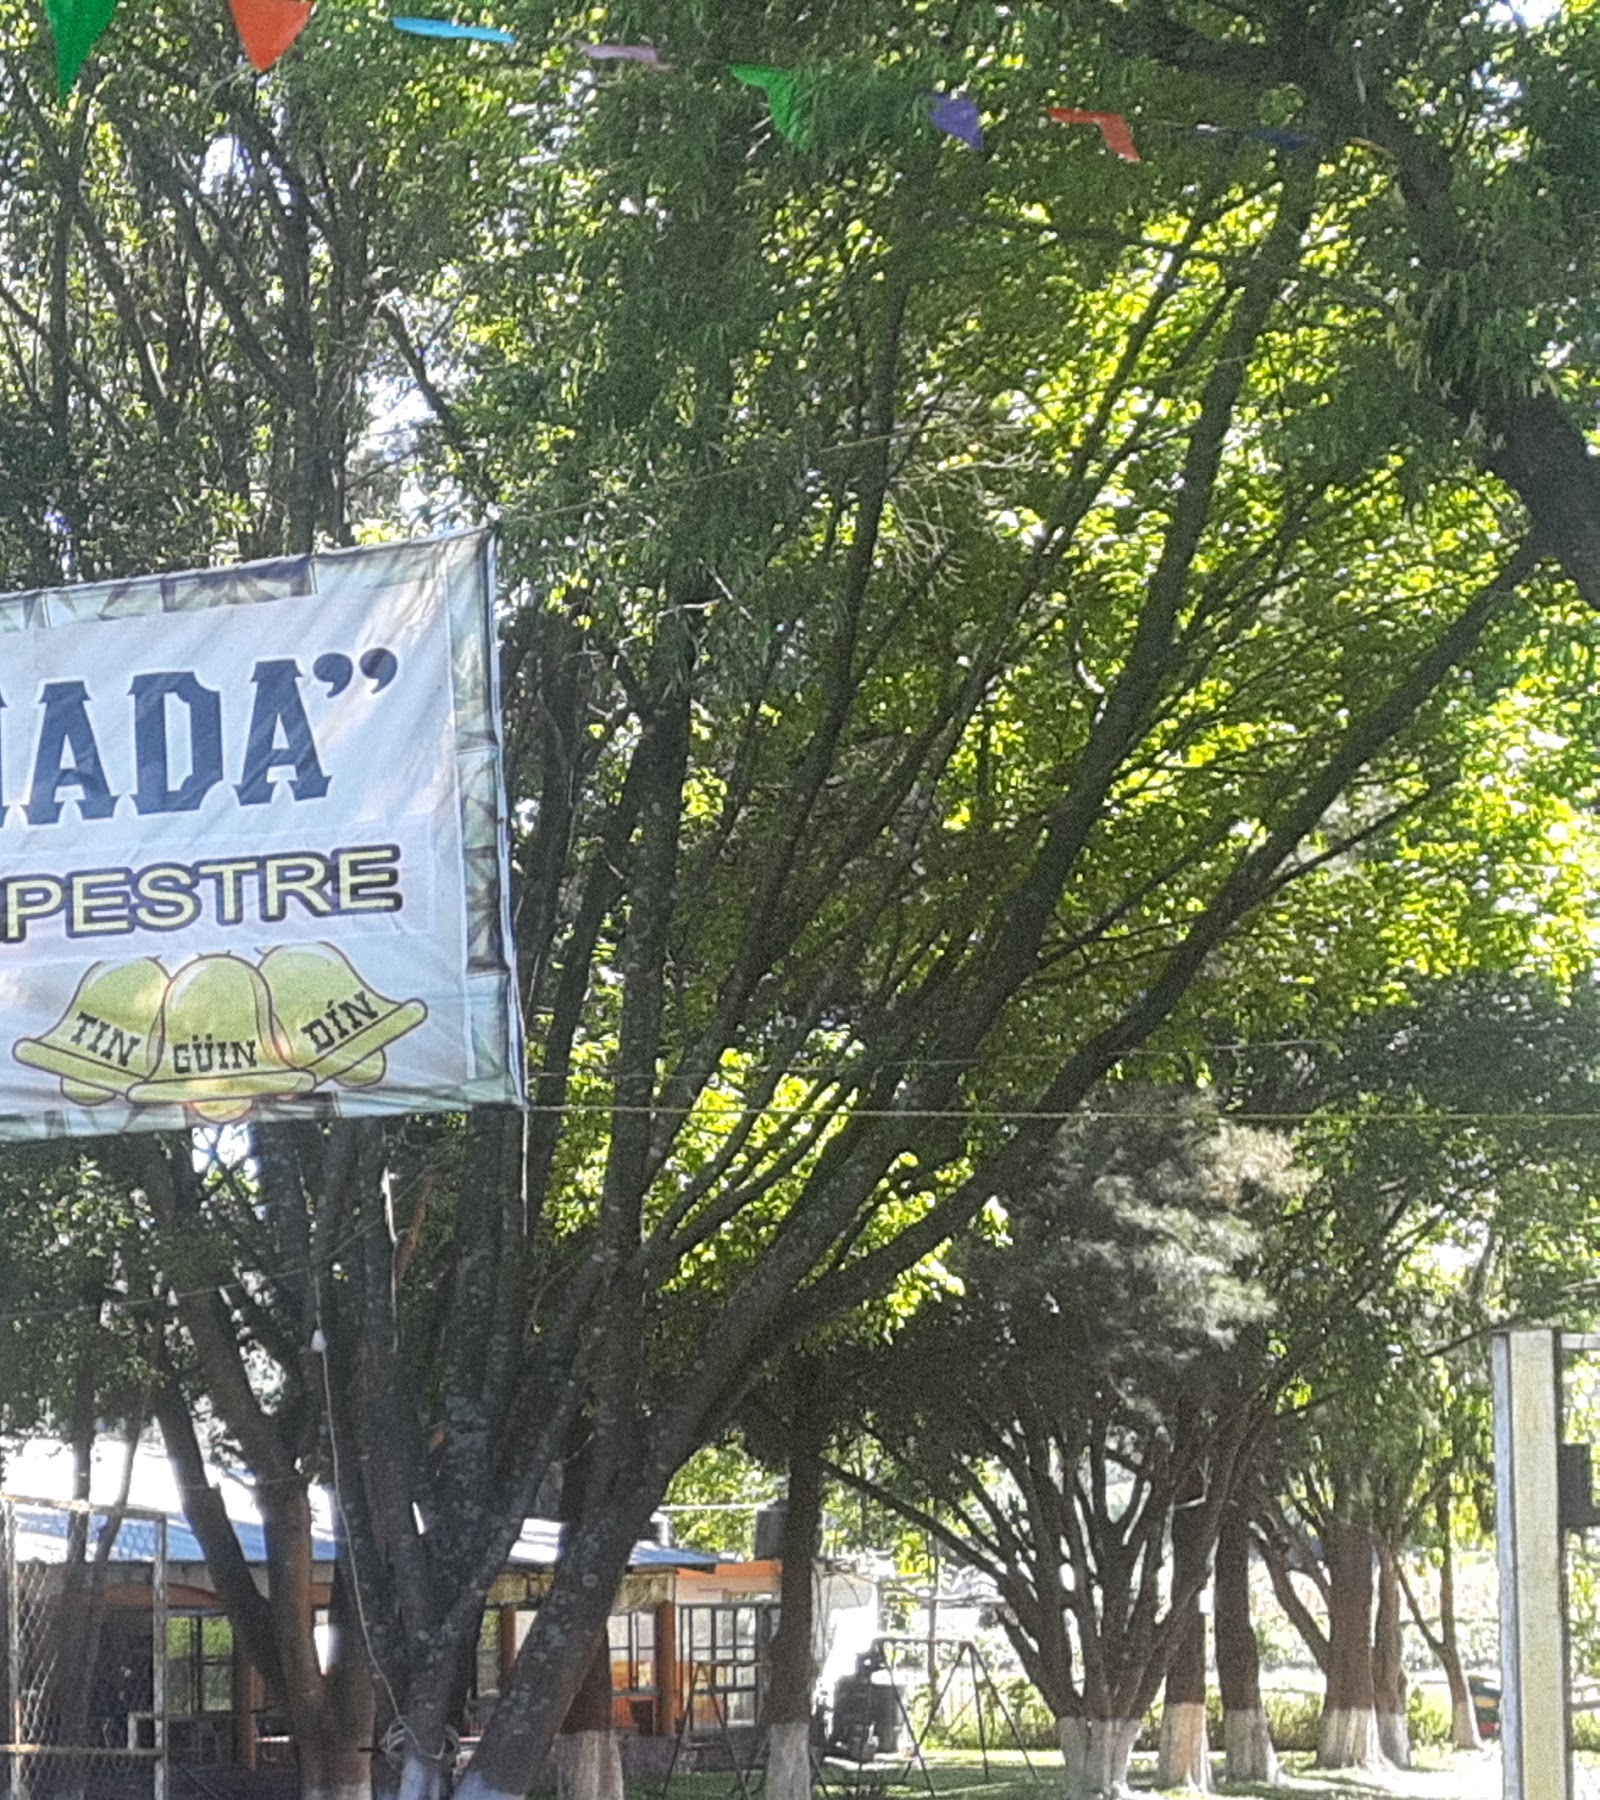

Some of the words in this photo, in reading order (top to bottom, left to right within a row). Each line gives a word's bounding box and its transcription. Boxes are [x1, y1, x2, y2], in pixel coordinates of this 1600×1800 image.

[70, 1011, 141, 1067] TIN
[174, 1034, 257, 1074] GÜIN
[300, 990, 379, 1053] DÍN
